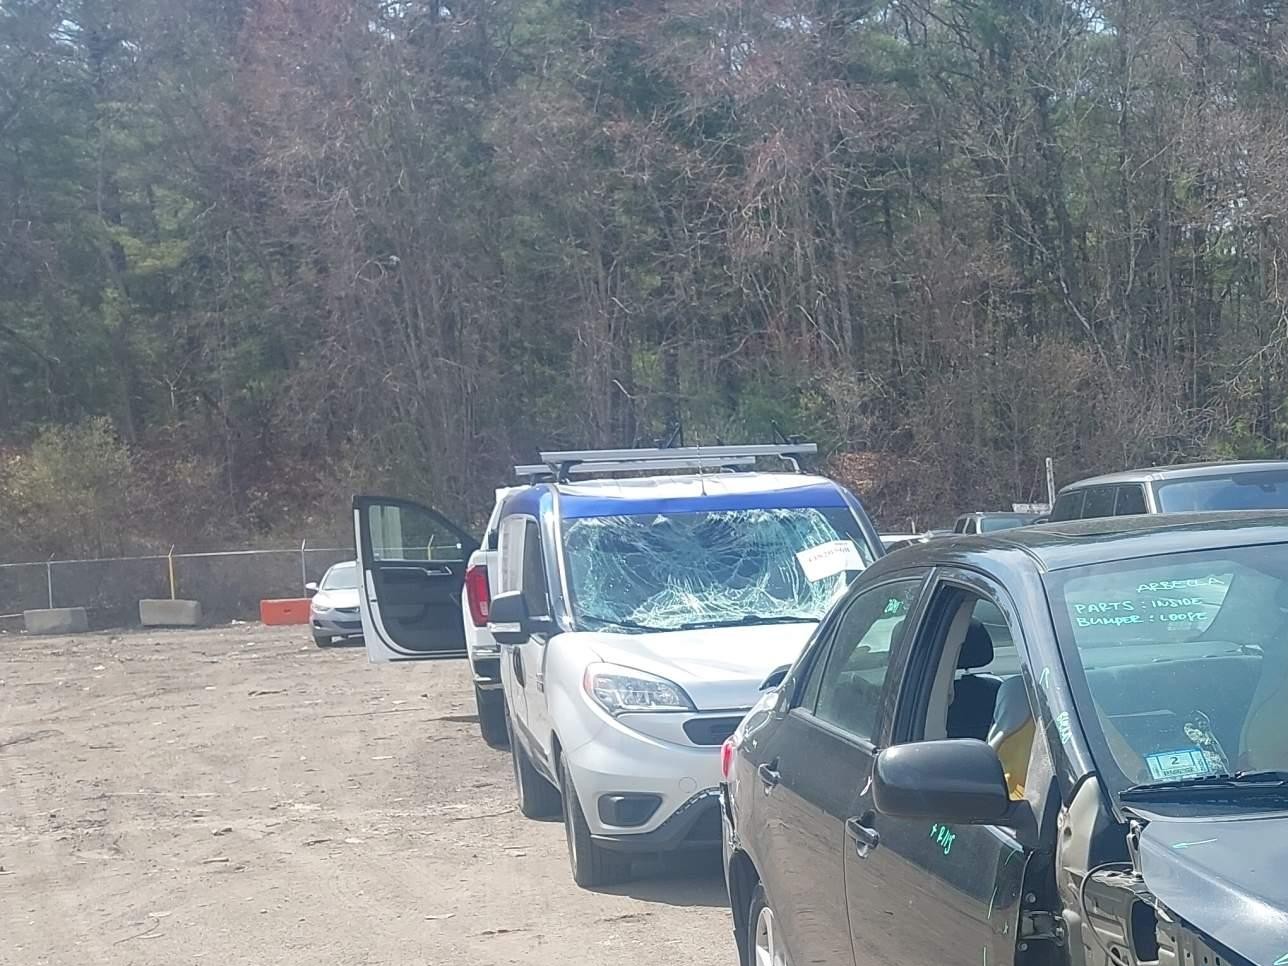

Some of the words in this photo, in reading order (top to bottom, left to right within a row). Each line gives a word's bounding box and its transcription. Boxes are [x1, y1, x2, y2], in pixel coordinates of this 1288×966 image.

[1075, 601, 1134, 614] PARTS
[1076, 615, 1144, 627] BUMPER
[1170, 757, 1181, 765] 2
